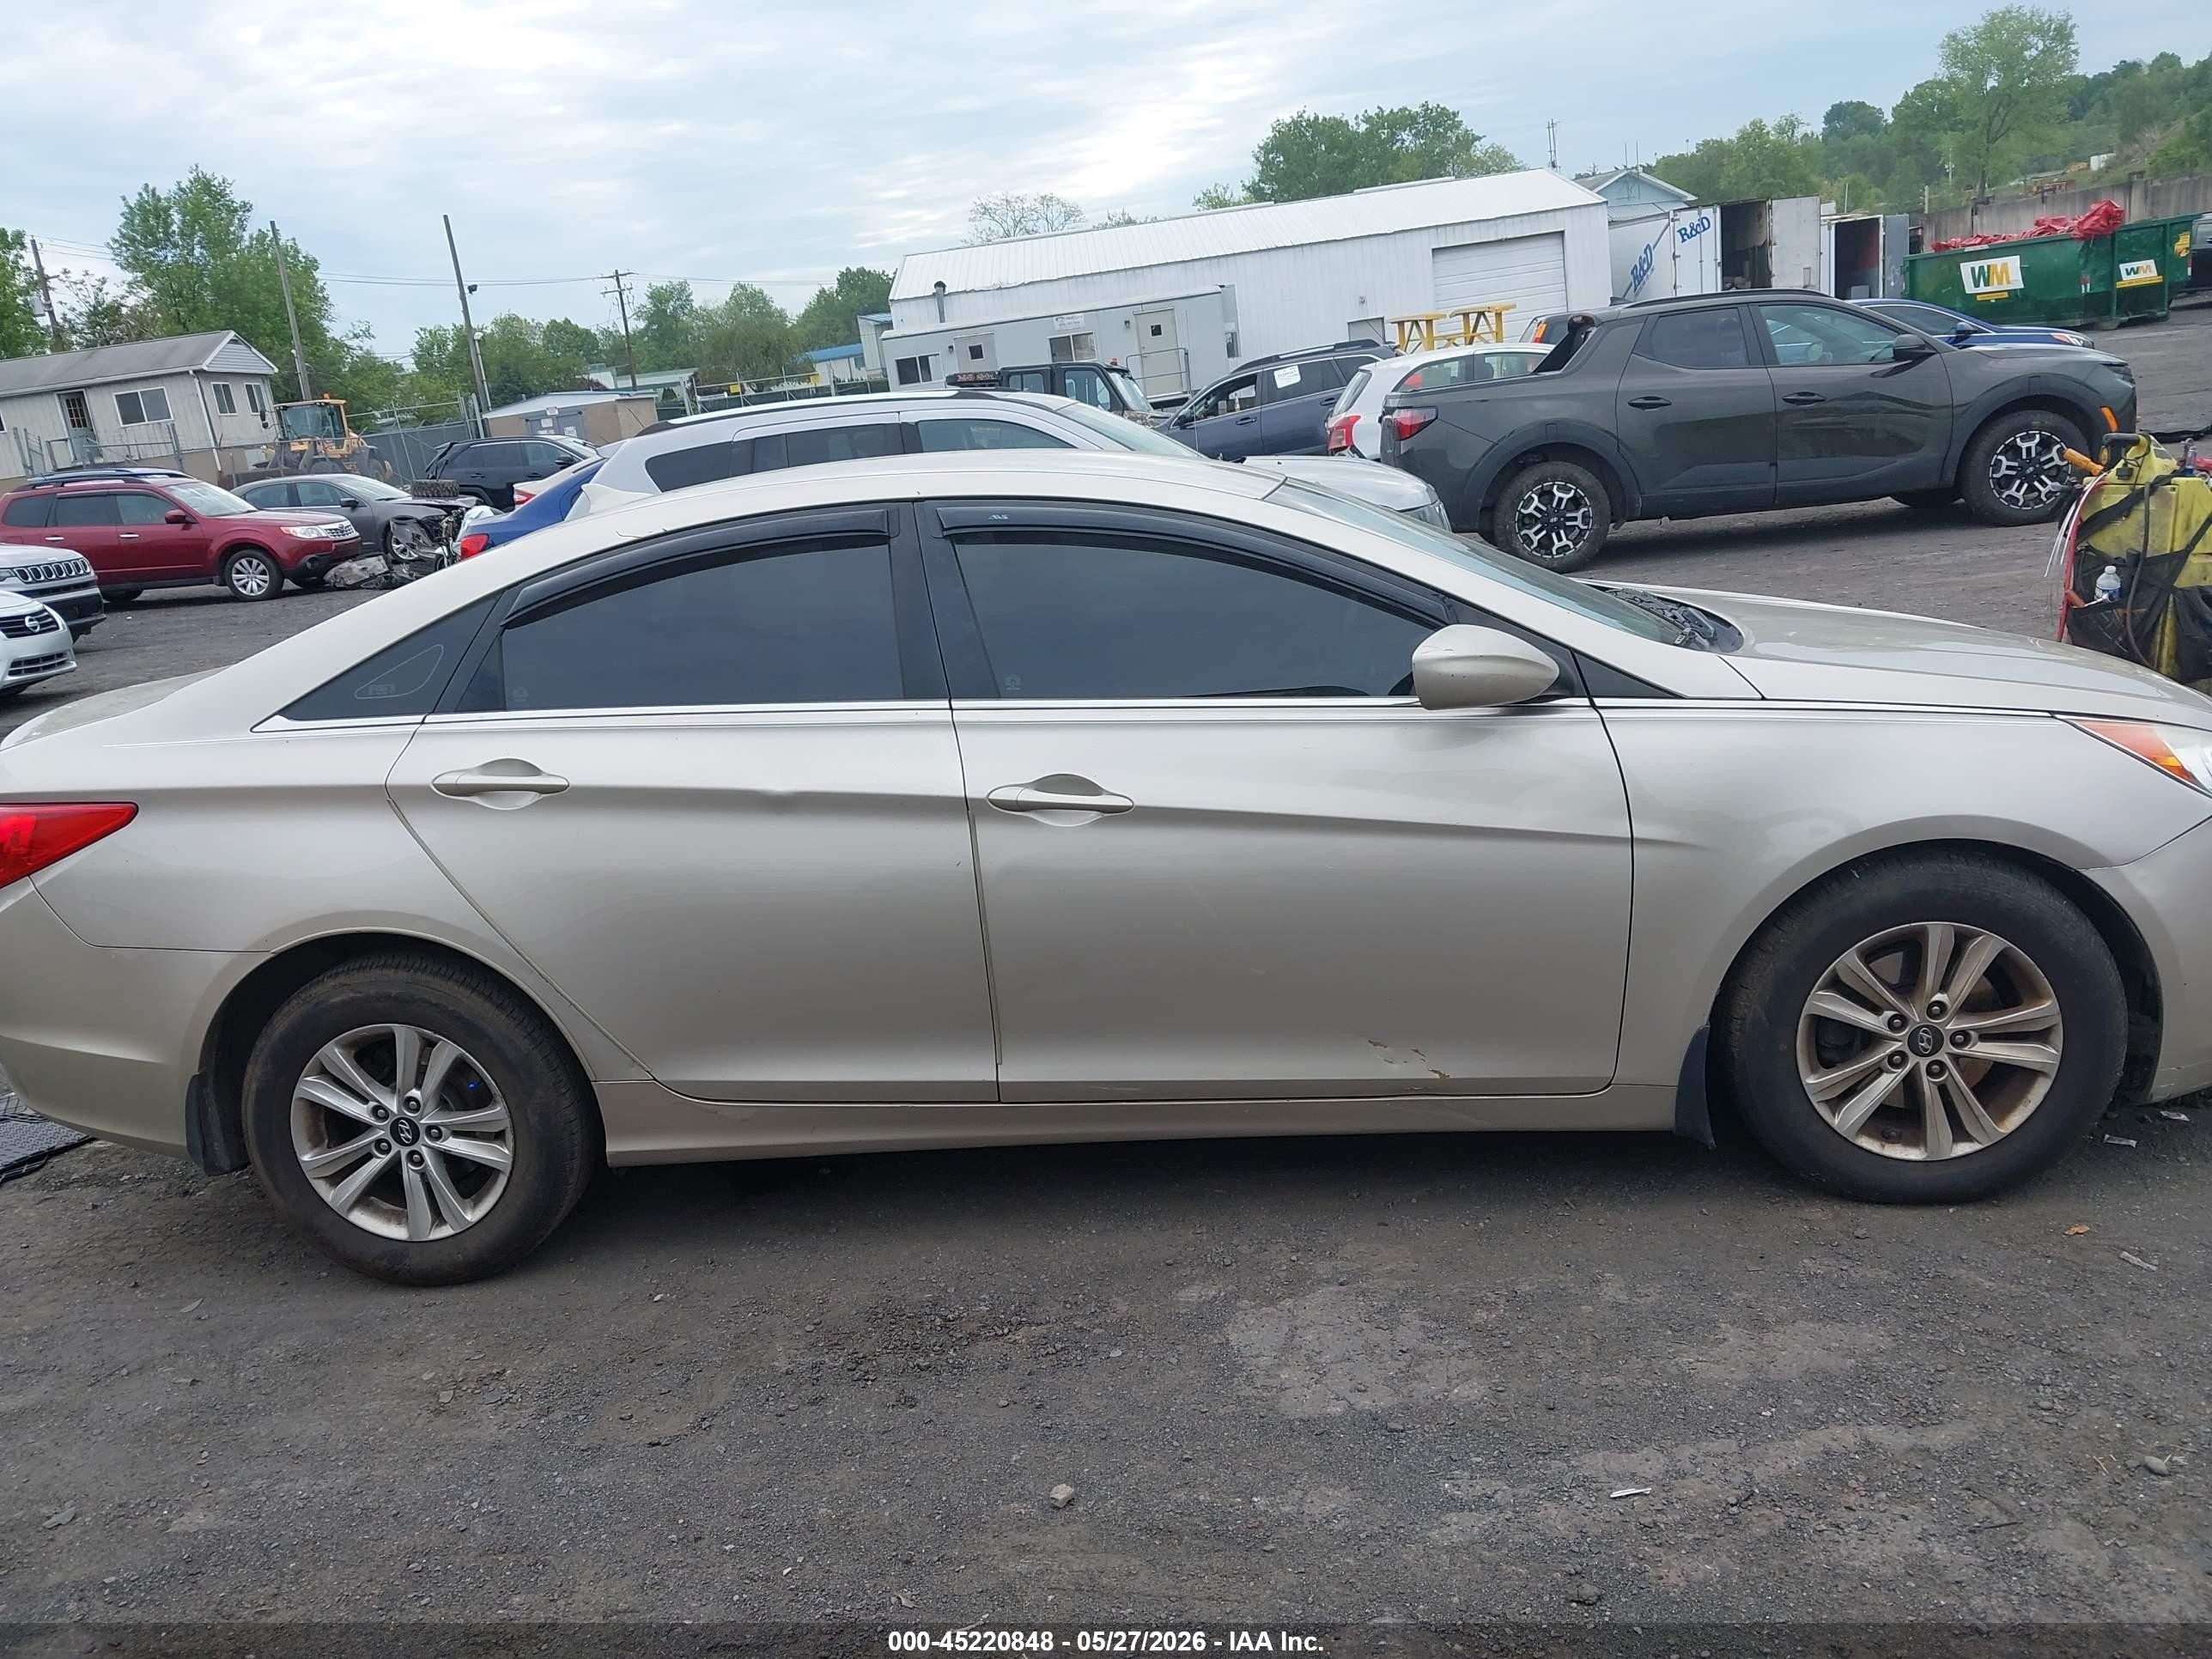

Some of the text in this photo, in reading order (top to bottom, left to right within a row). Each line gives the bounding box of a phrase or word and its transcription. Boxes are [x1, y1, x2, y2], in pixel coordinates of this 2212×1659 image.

[1677, 216, 1711, 243] R&D
[1631, 244, 1653, 293] R&D
[1970, 262, 2011, 288] WM
[2125, 265, 2152, 276] WM
